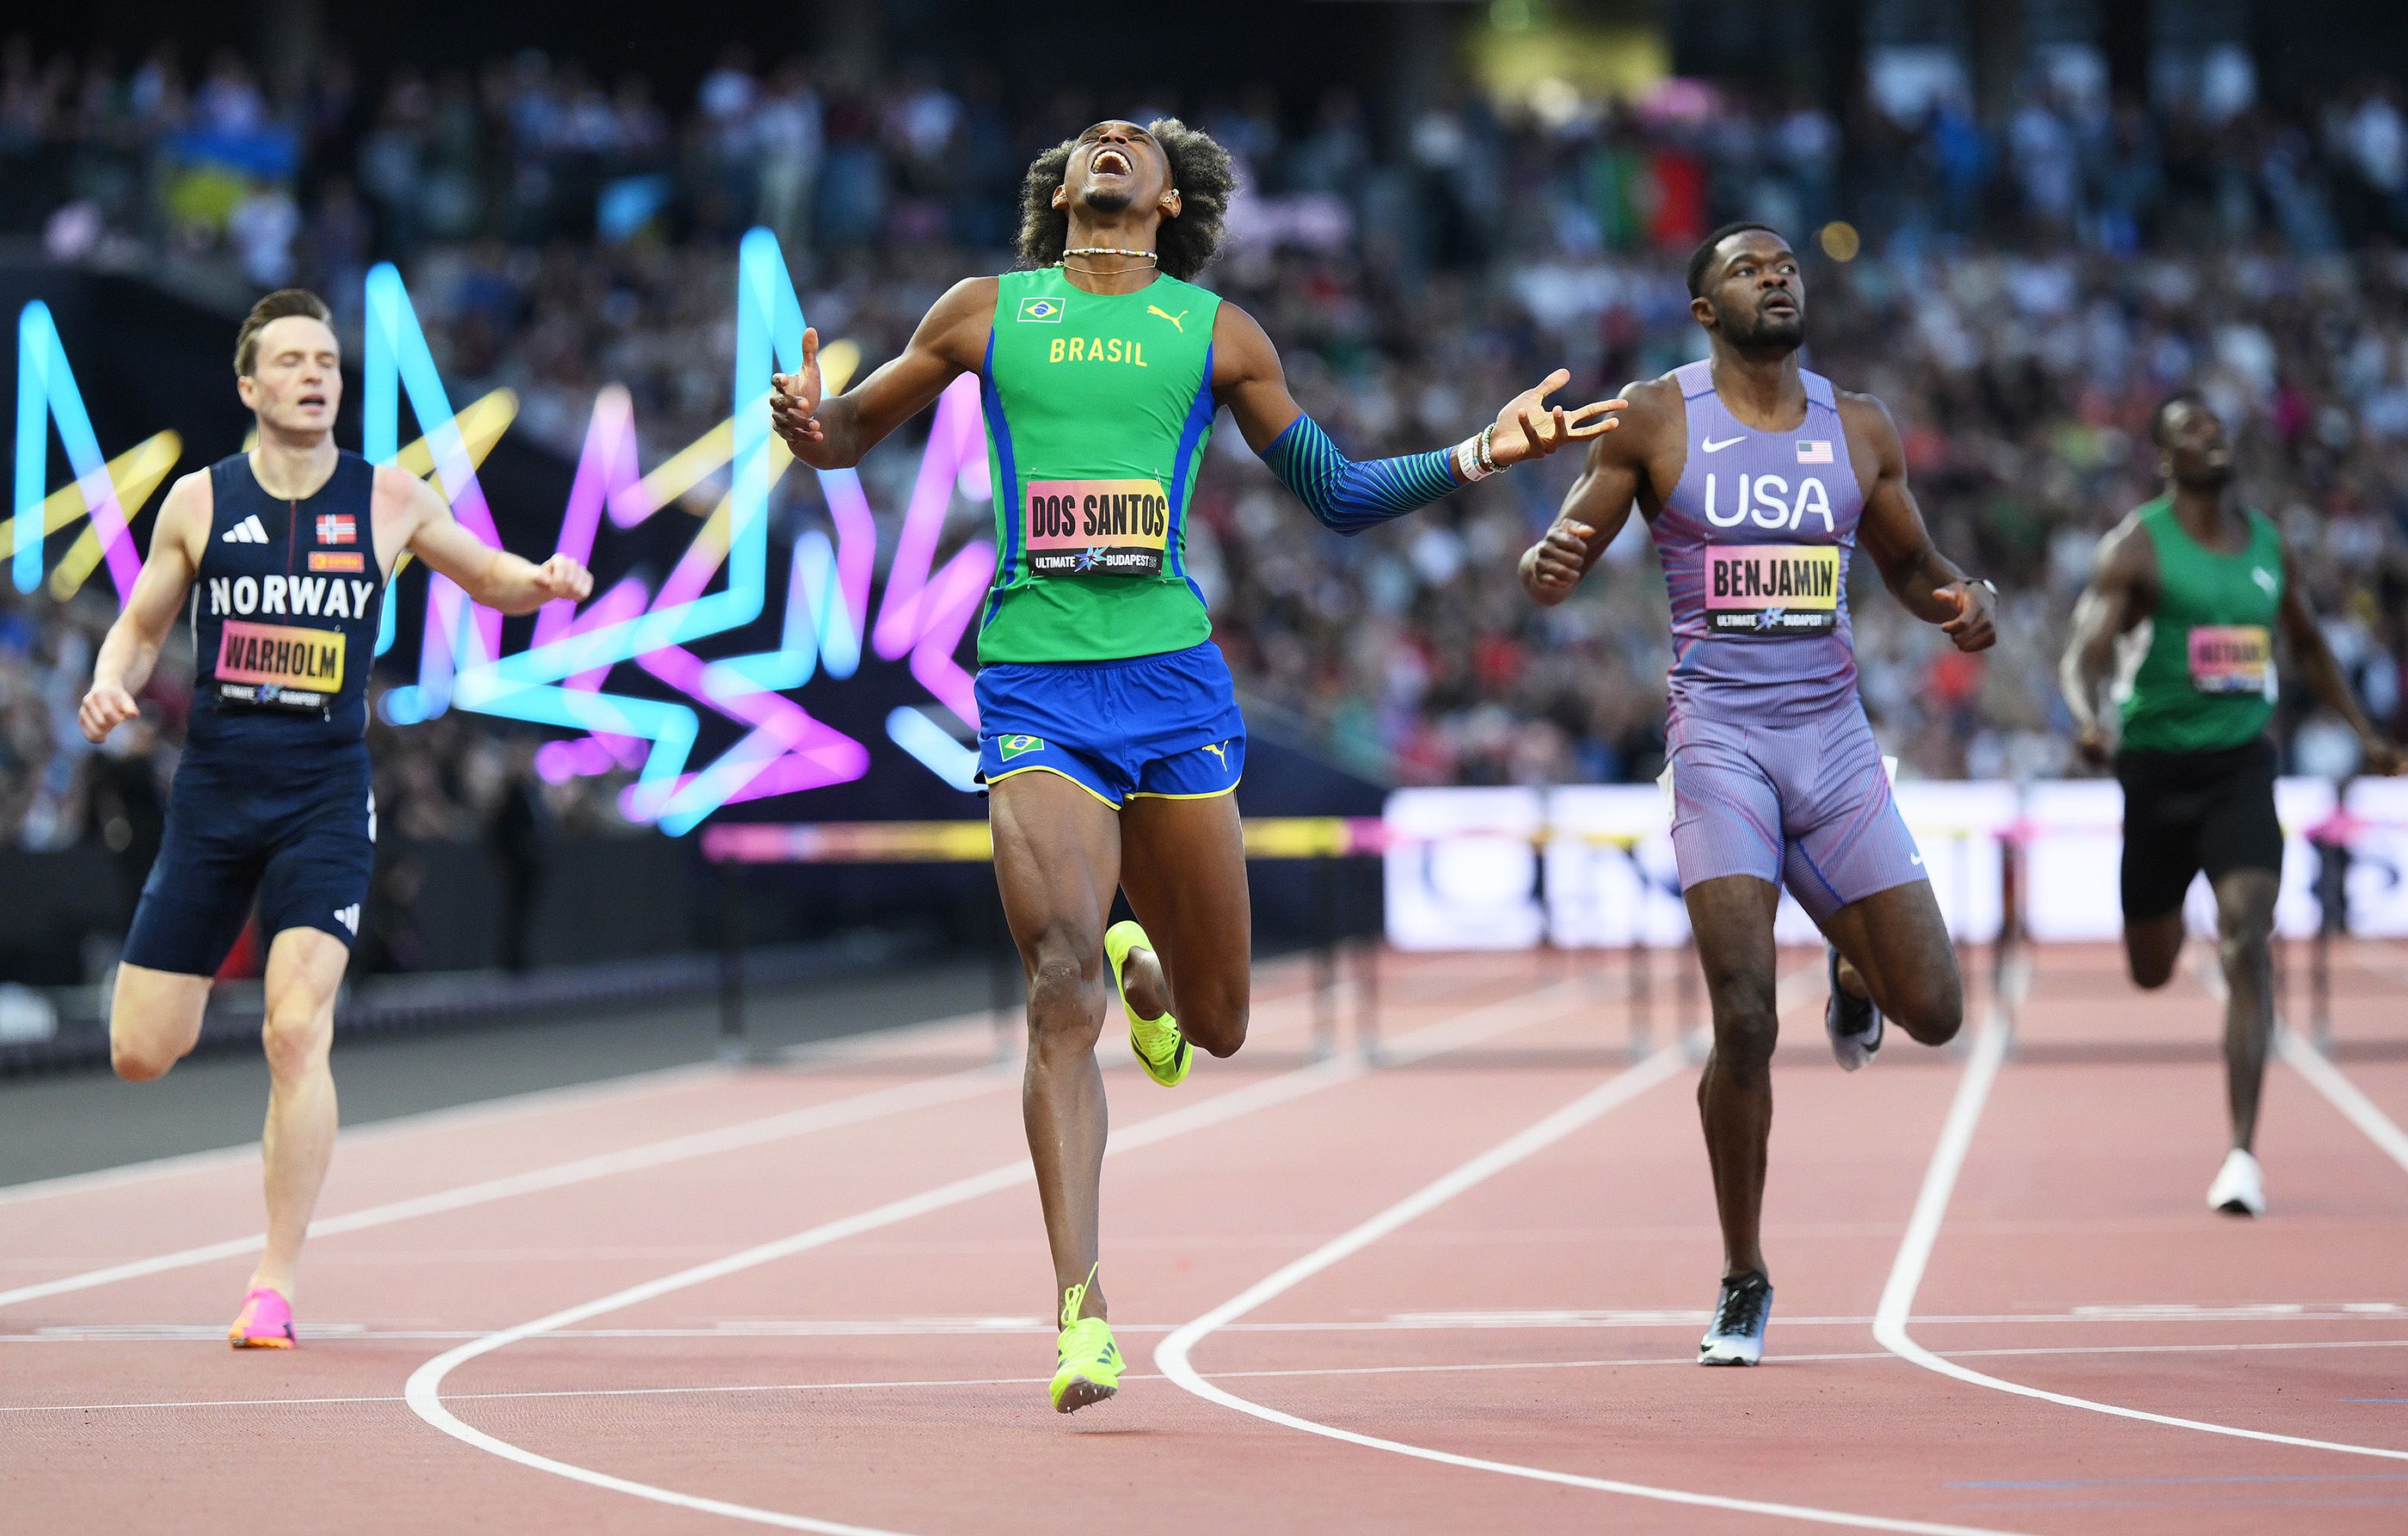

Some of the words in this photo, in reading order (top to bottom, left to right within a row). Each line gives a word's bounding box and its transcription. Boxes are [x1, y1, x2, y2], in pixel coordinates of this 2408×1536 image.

[1049, 337, 1147, 367] BRASIL
[1032, 495, 1076, 538] DOS
[1083, 494, 1165, 538] SANTOS
[1705, 473, 1834, 532] USA
[1035, 556, 1075, 568] ULTIMATE
[1713, 560, 1833, 597] BENJAMIN
[210, 574, 374, 619] NORWAY
[1717, 614, 1757, 626] ULTIMATE
[224, 635, 336, 679] WARHOLM
